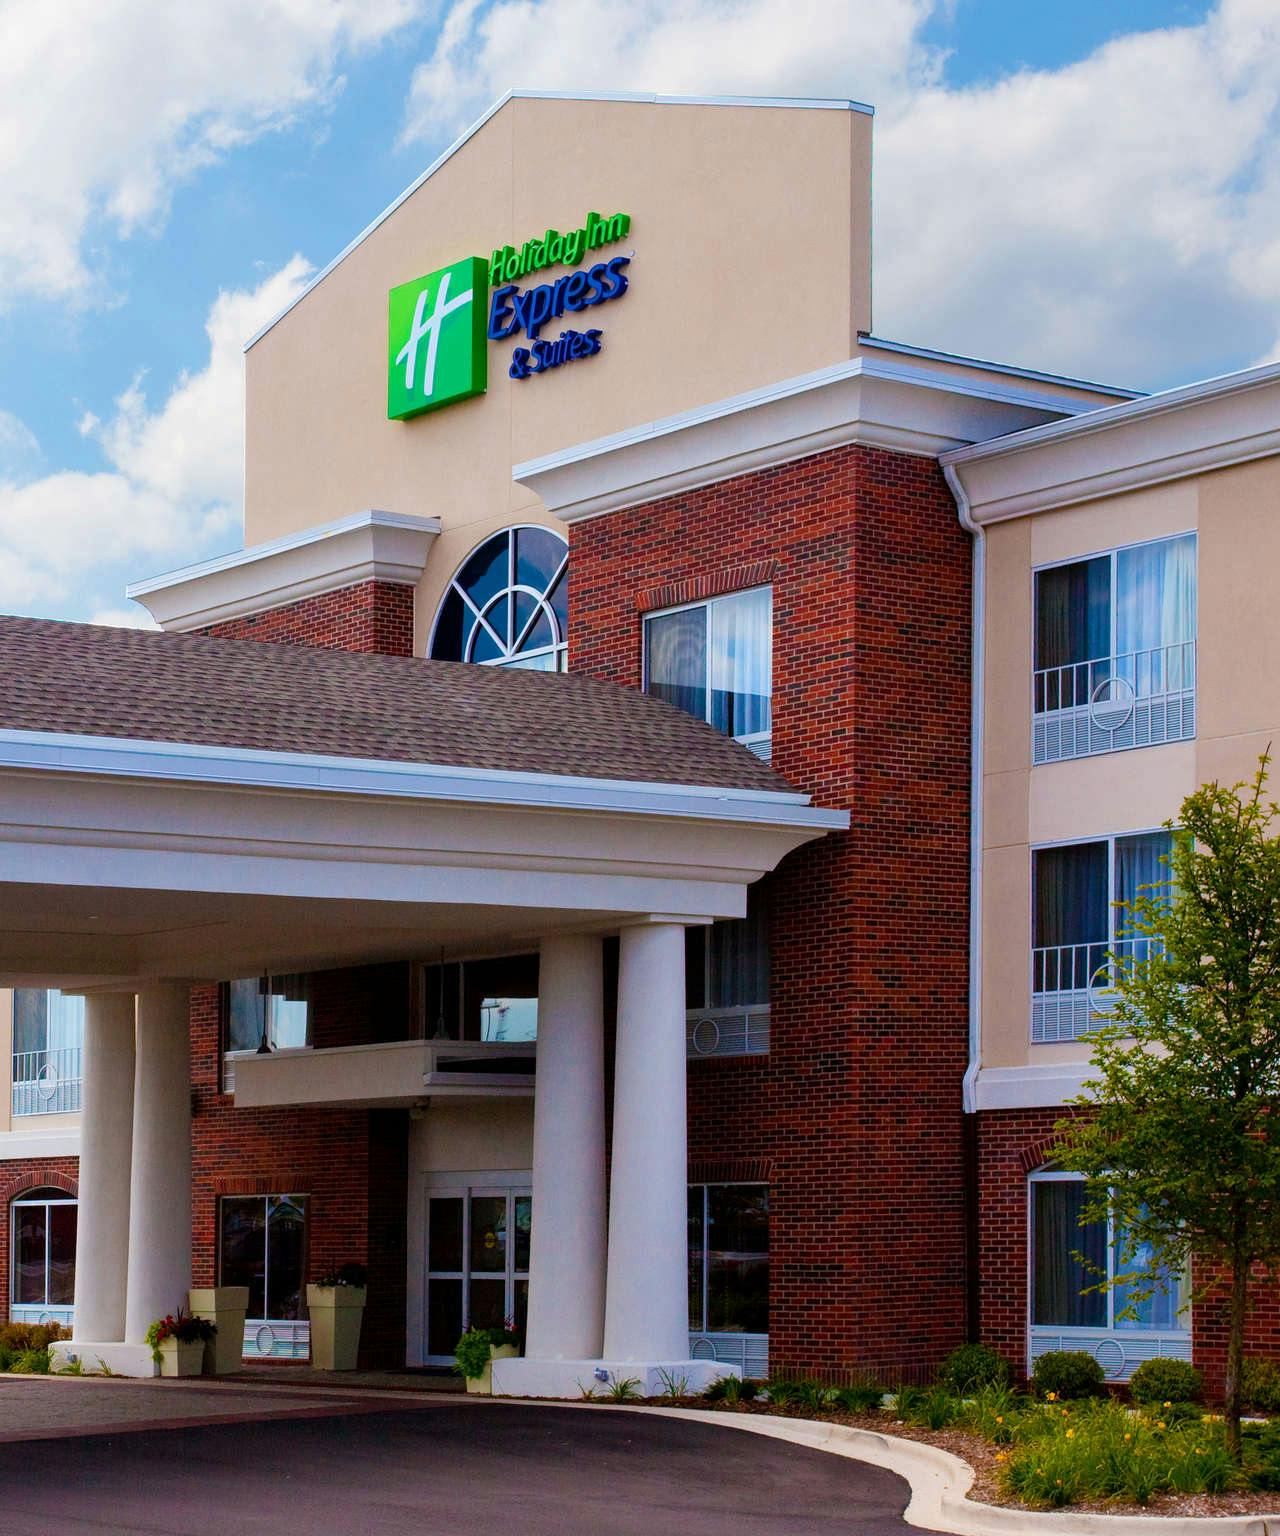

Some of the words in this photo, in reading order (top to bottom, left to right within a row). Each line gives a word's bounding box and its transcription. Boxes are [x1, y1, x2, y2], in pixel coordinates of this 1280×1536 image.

[489, 230, 584, 286] Holiday
[585, 212, 630, 249] Inn
[488, 257, 630, 340] Express
[509, 347, 531, 379] &
[529, 329, 603, 373] Suites
